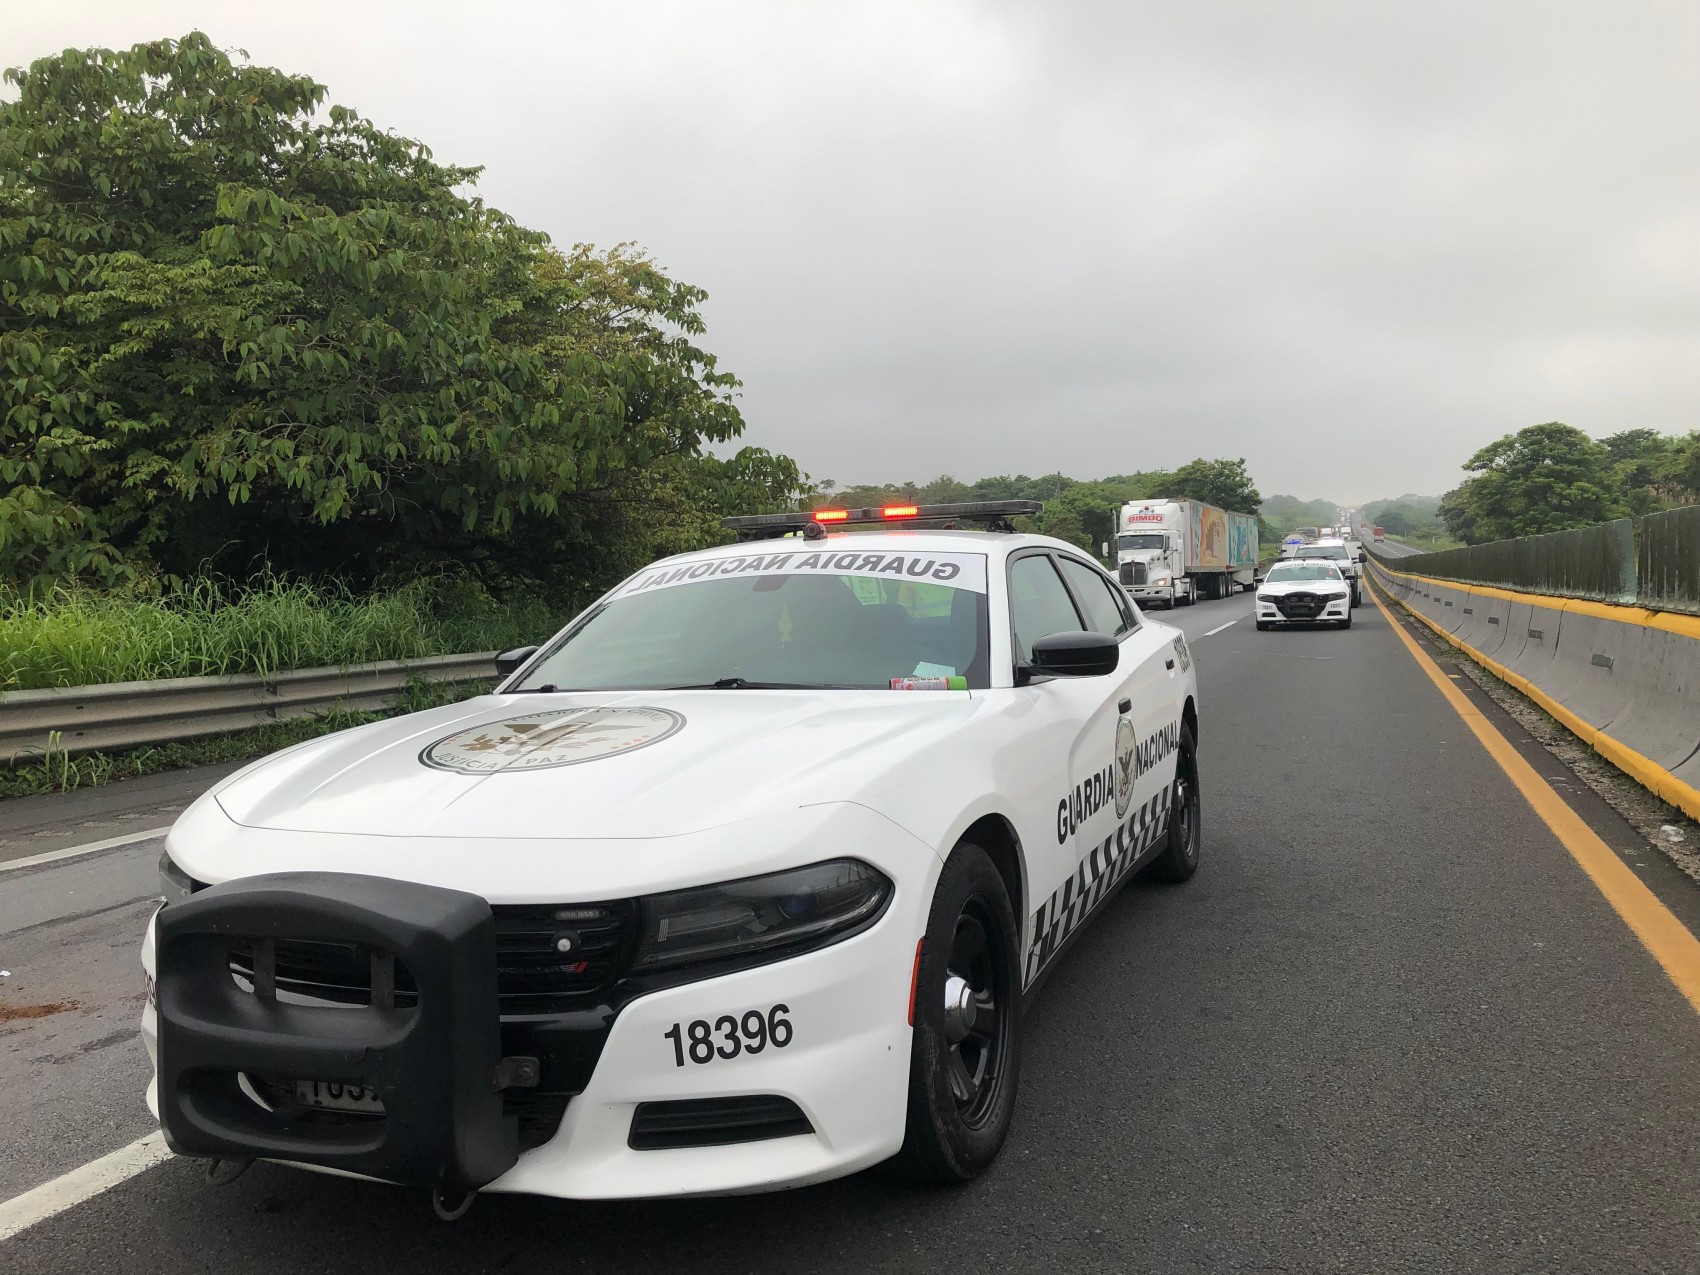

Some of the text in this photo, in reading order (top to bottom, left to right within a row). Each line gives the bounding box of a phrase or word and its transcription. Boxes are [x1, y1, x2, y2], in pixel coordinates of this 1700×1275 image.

[525, 754, 568, 765] PAZ
[1057, 719, 1179, 845] GUARDIA NACIONAL
[664, 1003, 793, 1067] 18396
